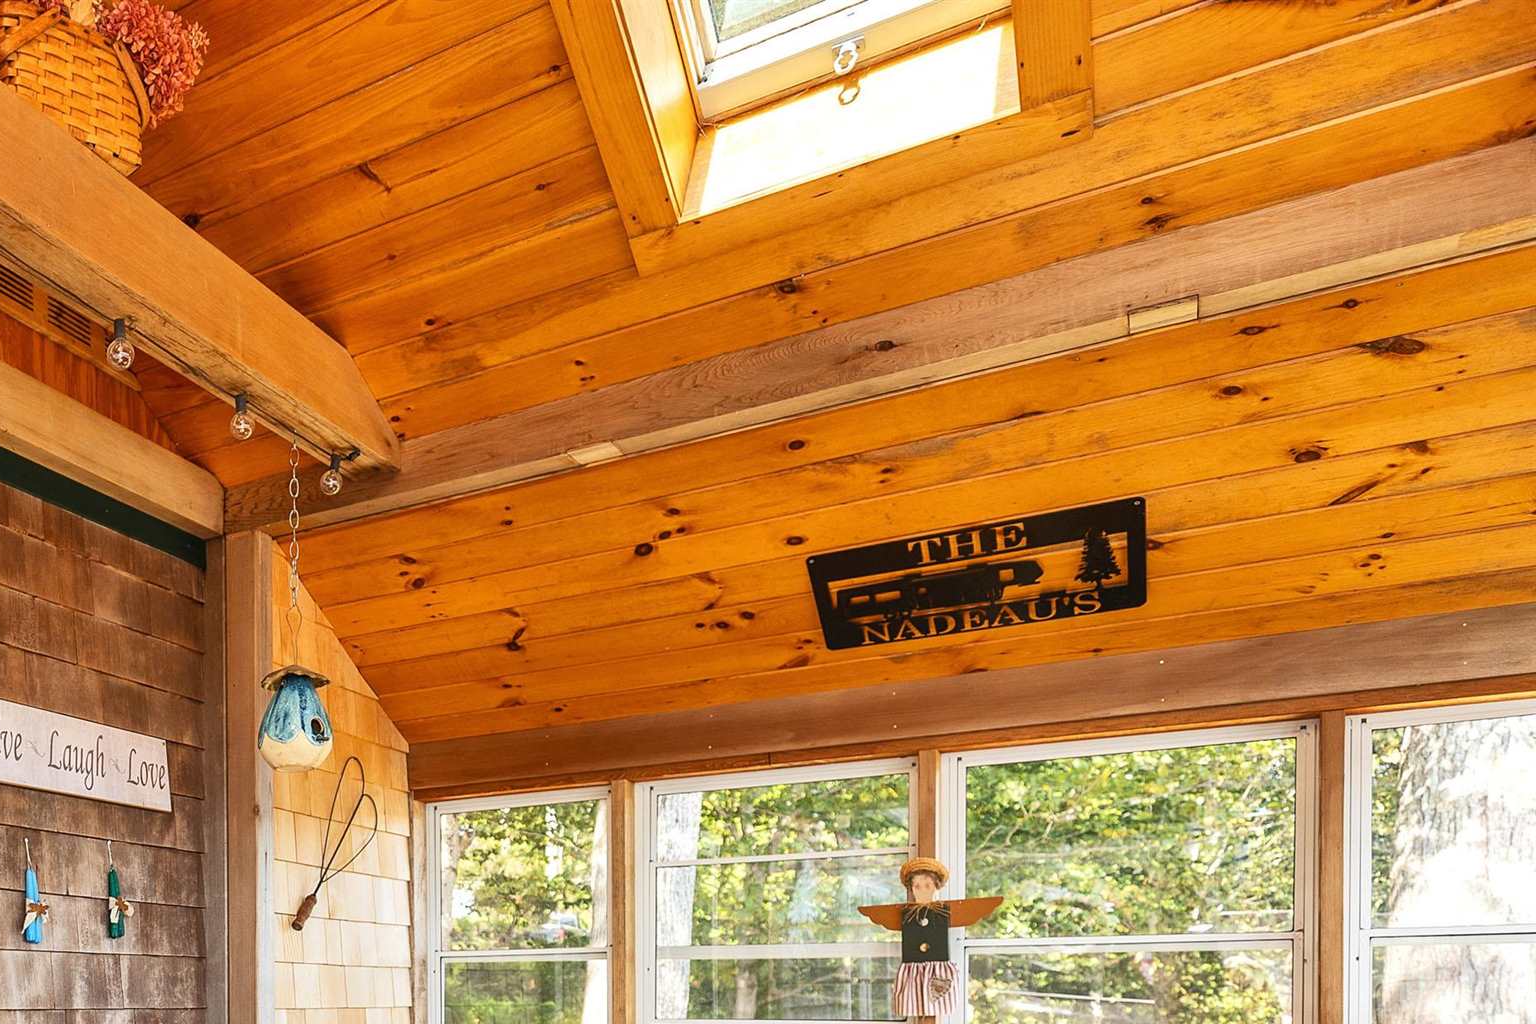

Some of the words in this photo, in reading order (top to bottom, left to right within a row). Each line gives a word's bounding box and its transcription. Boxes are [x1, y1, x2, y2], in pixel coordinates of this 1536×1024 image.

[907, 522, 1027, 565] THE
[860, 590, 1102, 645] NADEAU'S
[48, 730, 106, 791] Laugh
[127, 748, 166, 790] Love
